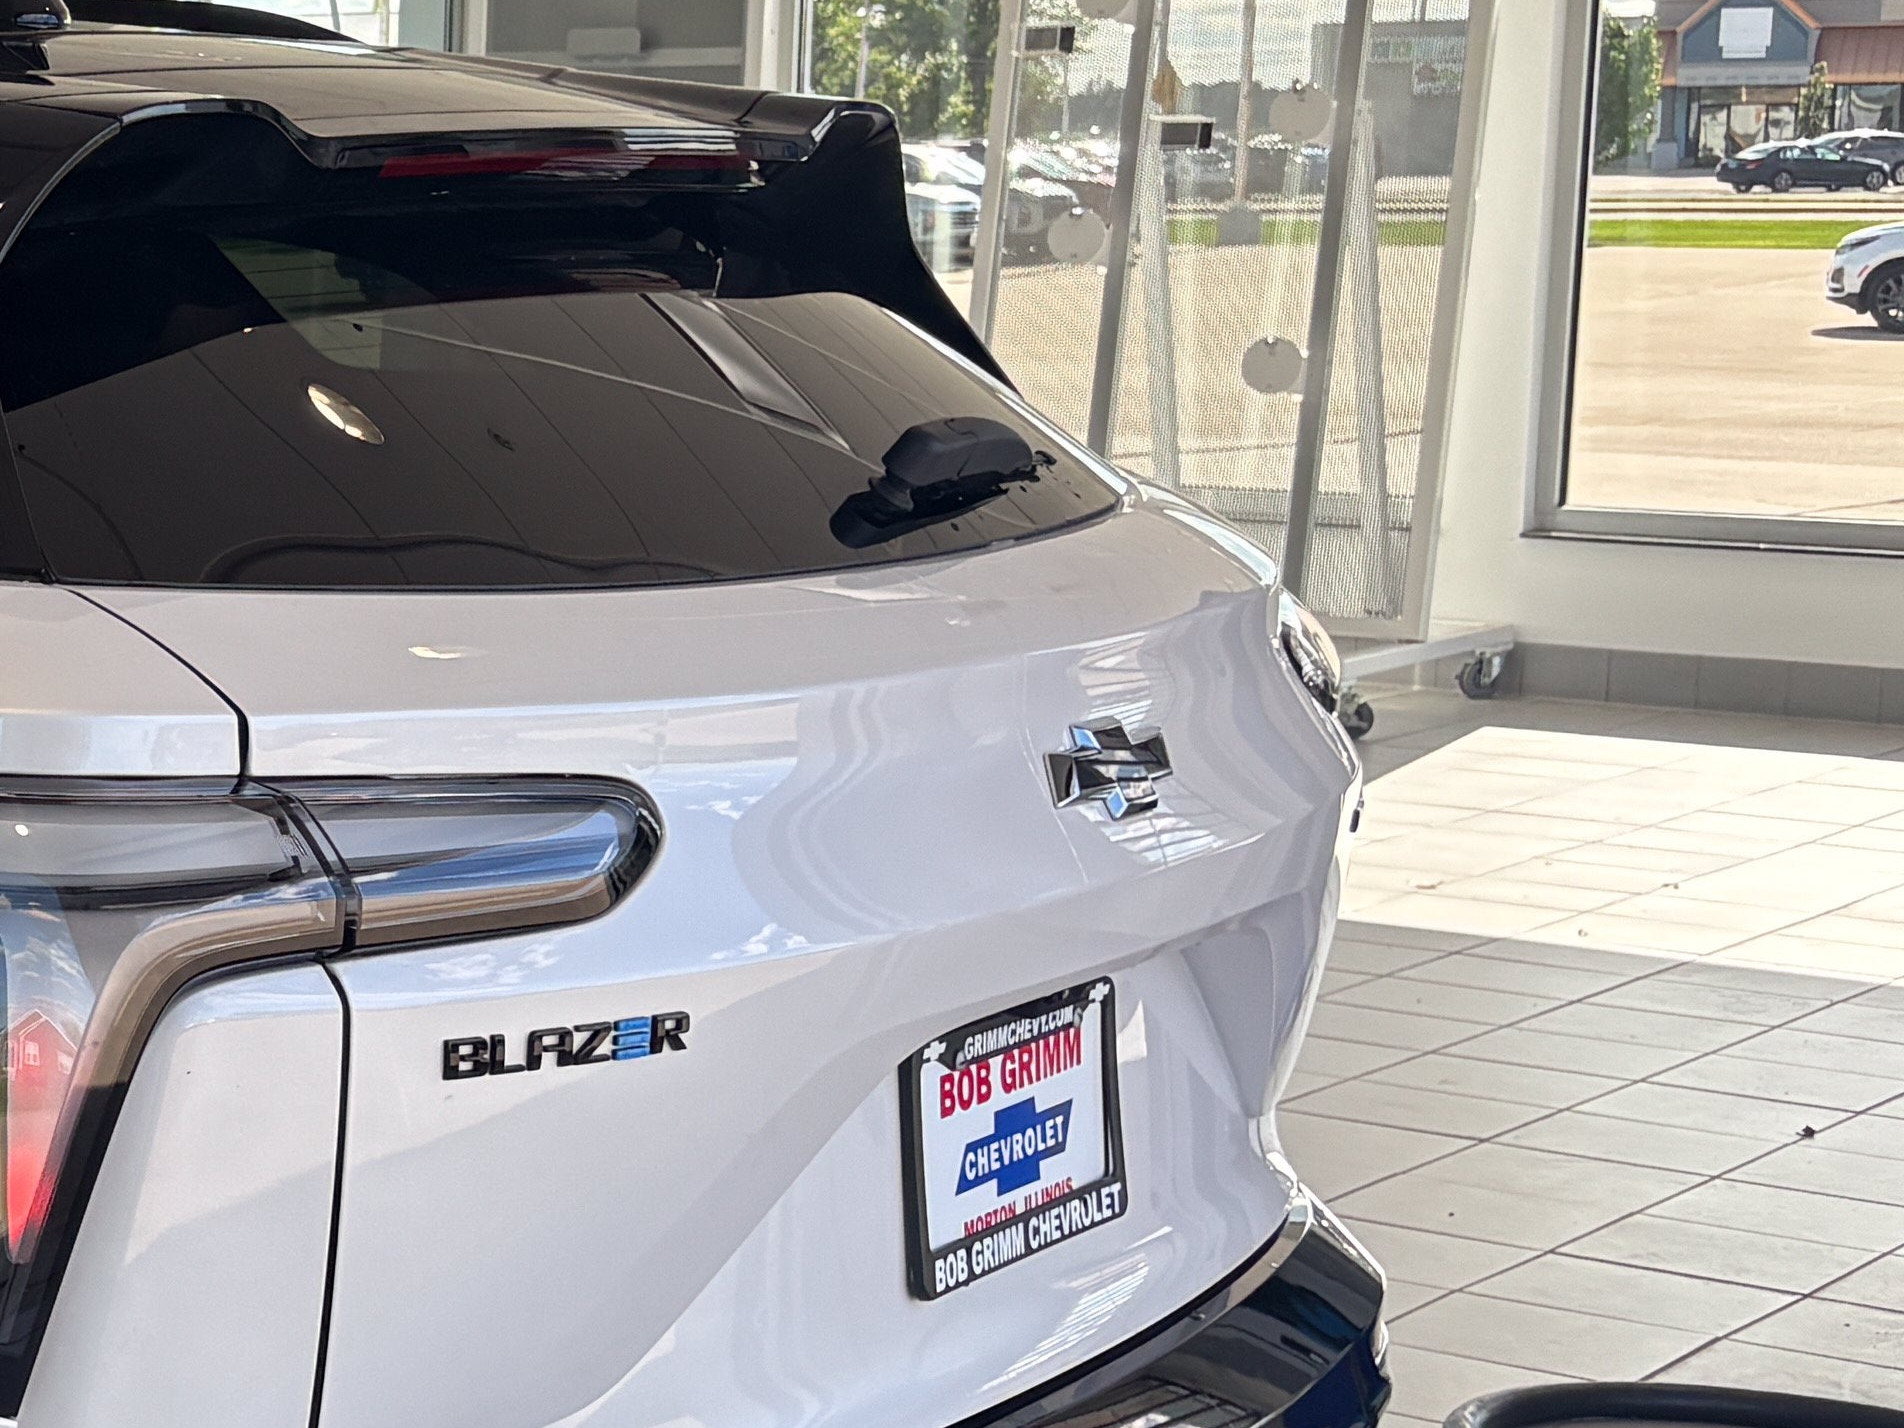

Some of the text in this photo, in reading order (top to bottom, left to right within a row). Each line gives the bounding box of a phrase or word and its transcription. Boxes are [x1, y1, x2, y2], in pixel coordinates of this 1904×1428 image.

[442, 1011, 690, 1080] BLAZER
[940, 1027, 1082, 1119] BOB GRIMM
[964, 1114, 1065, 1181] CHEVROLET
[934, 1182, 1122, 1293] BOB GRIMM CHEVROLET
